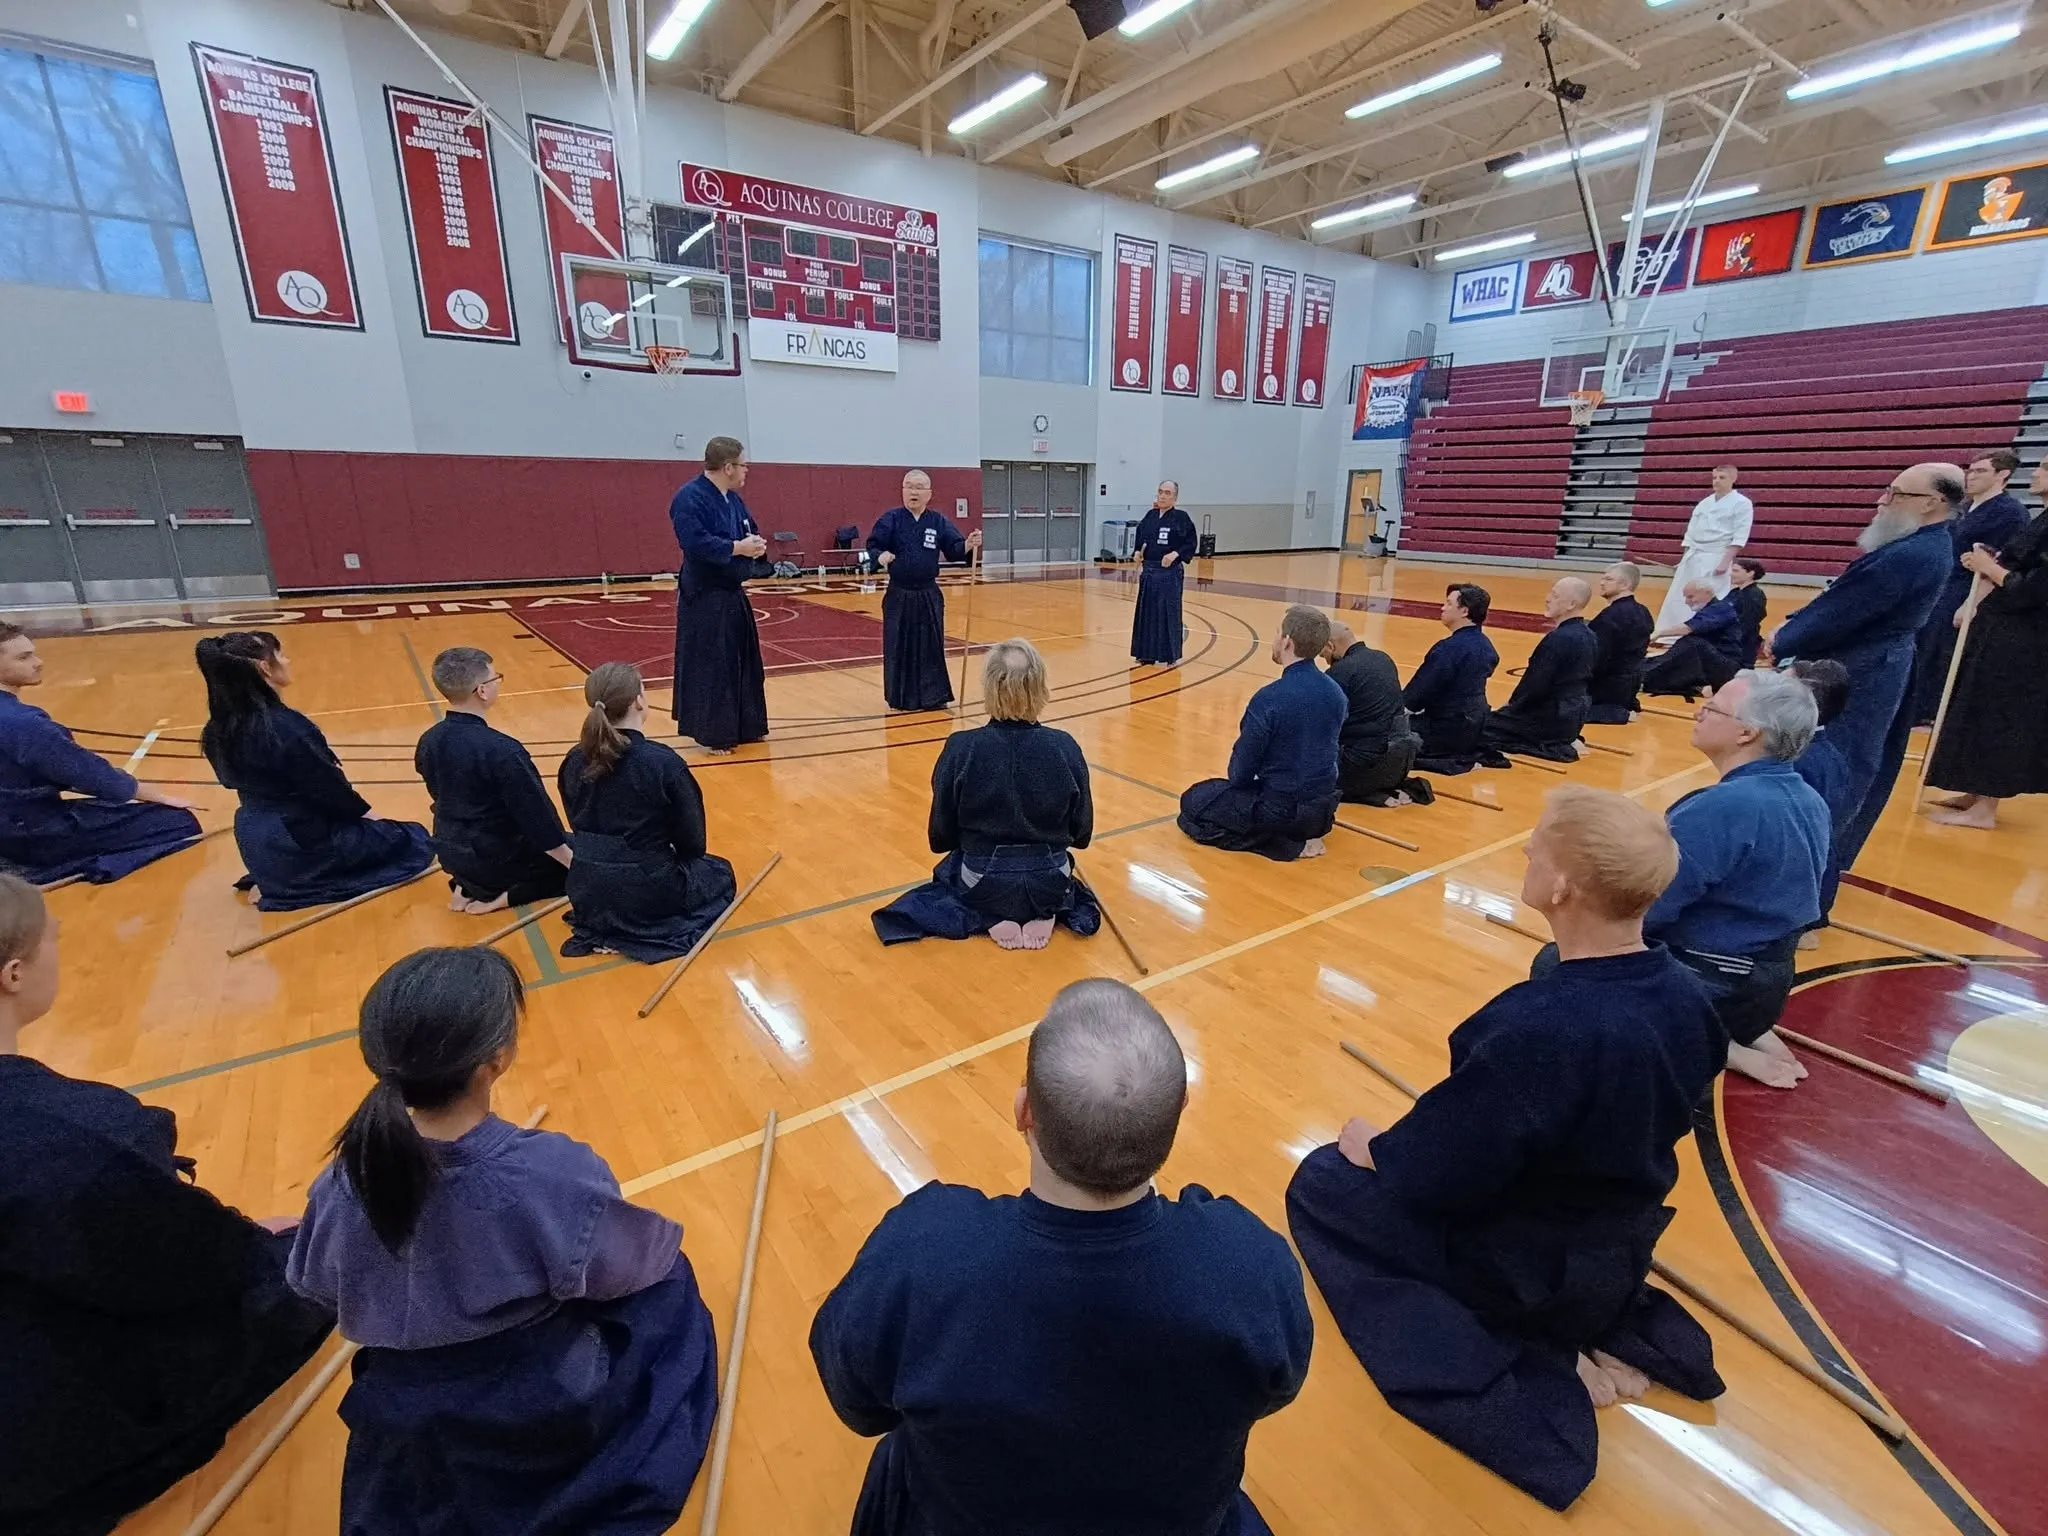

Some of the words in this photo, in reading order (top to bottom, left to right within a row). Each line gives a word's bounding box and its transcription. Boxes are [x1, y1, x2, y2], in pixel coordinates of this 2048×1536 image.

[207, 61, 258, 83] AQUINAS
[260, 73, 312, 93] COLLEGE
[243, 80, 281, 97] MEN'S
[227, 89, 300, 113] BASKETBALL
[396, 101, 439, 120] AQUINAS
[219, 99, 313, 128] CHAMPIONSHIPS
[256, 119, 284, 133] 1993
[418, 116, 464, 134] WOMEN'S
[405, 135, 483, 159] CHAMPIONSHIPS
[412, 126, 473, 147] BASKETBALL
[538, 128, 575, 144] AQUINAS
[576, 136, 612, 152] COLLEGE
[552, 151, 603, 169] VOLLEYBALL
[556, 142, 597, 158] WOMEN'S
[263, 155, 290, 168] 2007
[436, 163, 459, 175] 1992
[545, 159, 612, 181] CHAMPIONSHIPS
[437, 173, 461, 186] 1993
[439, 184, 463, 197] 1994
[441, 195, 464, 207] 1995
[740, 183, 821, 217] AQUINAS
[826, 199, 895, 230] COLLEGE
[726, 214, 740, 224] PTS
[895, 220, 936, 244] Saints
[763, 267, 787, 279] BONUS
[805, 268, 829, 279] PERIOD
[859, 281, 881, 292] BONUS
[1534, 259, 1582, 299] AQ
[751, 280, 774, 291] FOULS
[800, 287, 825, 297] PLAYER
[834, 291, 854, 301] FOULS
[873, 297, 892, 306] FOULS
[1462, 276, 1509, 304] WHAC
[785, 312, 798, 322] TOL
[854, 320, 866, 330] TOL
[83, 593, 651, 632] AQUINAS
